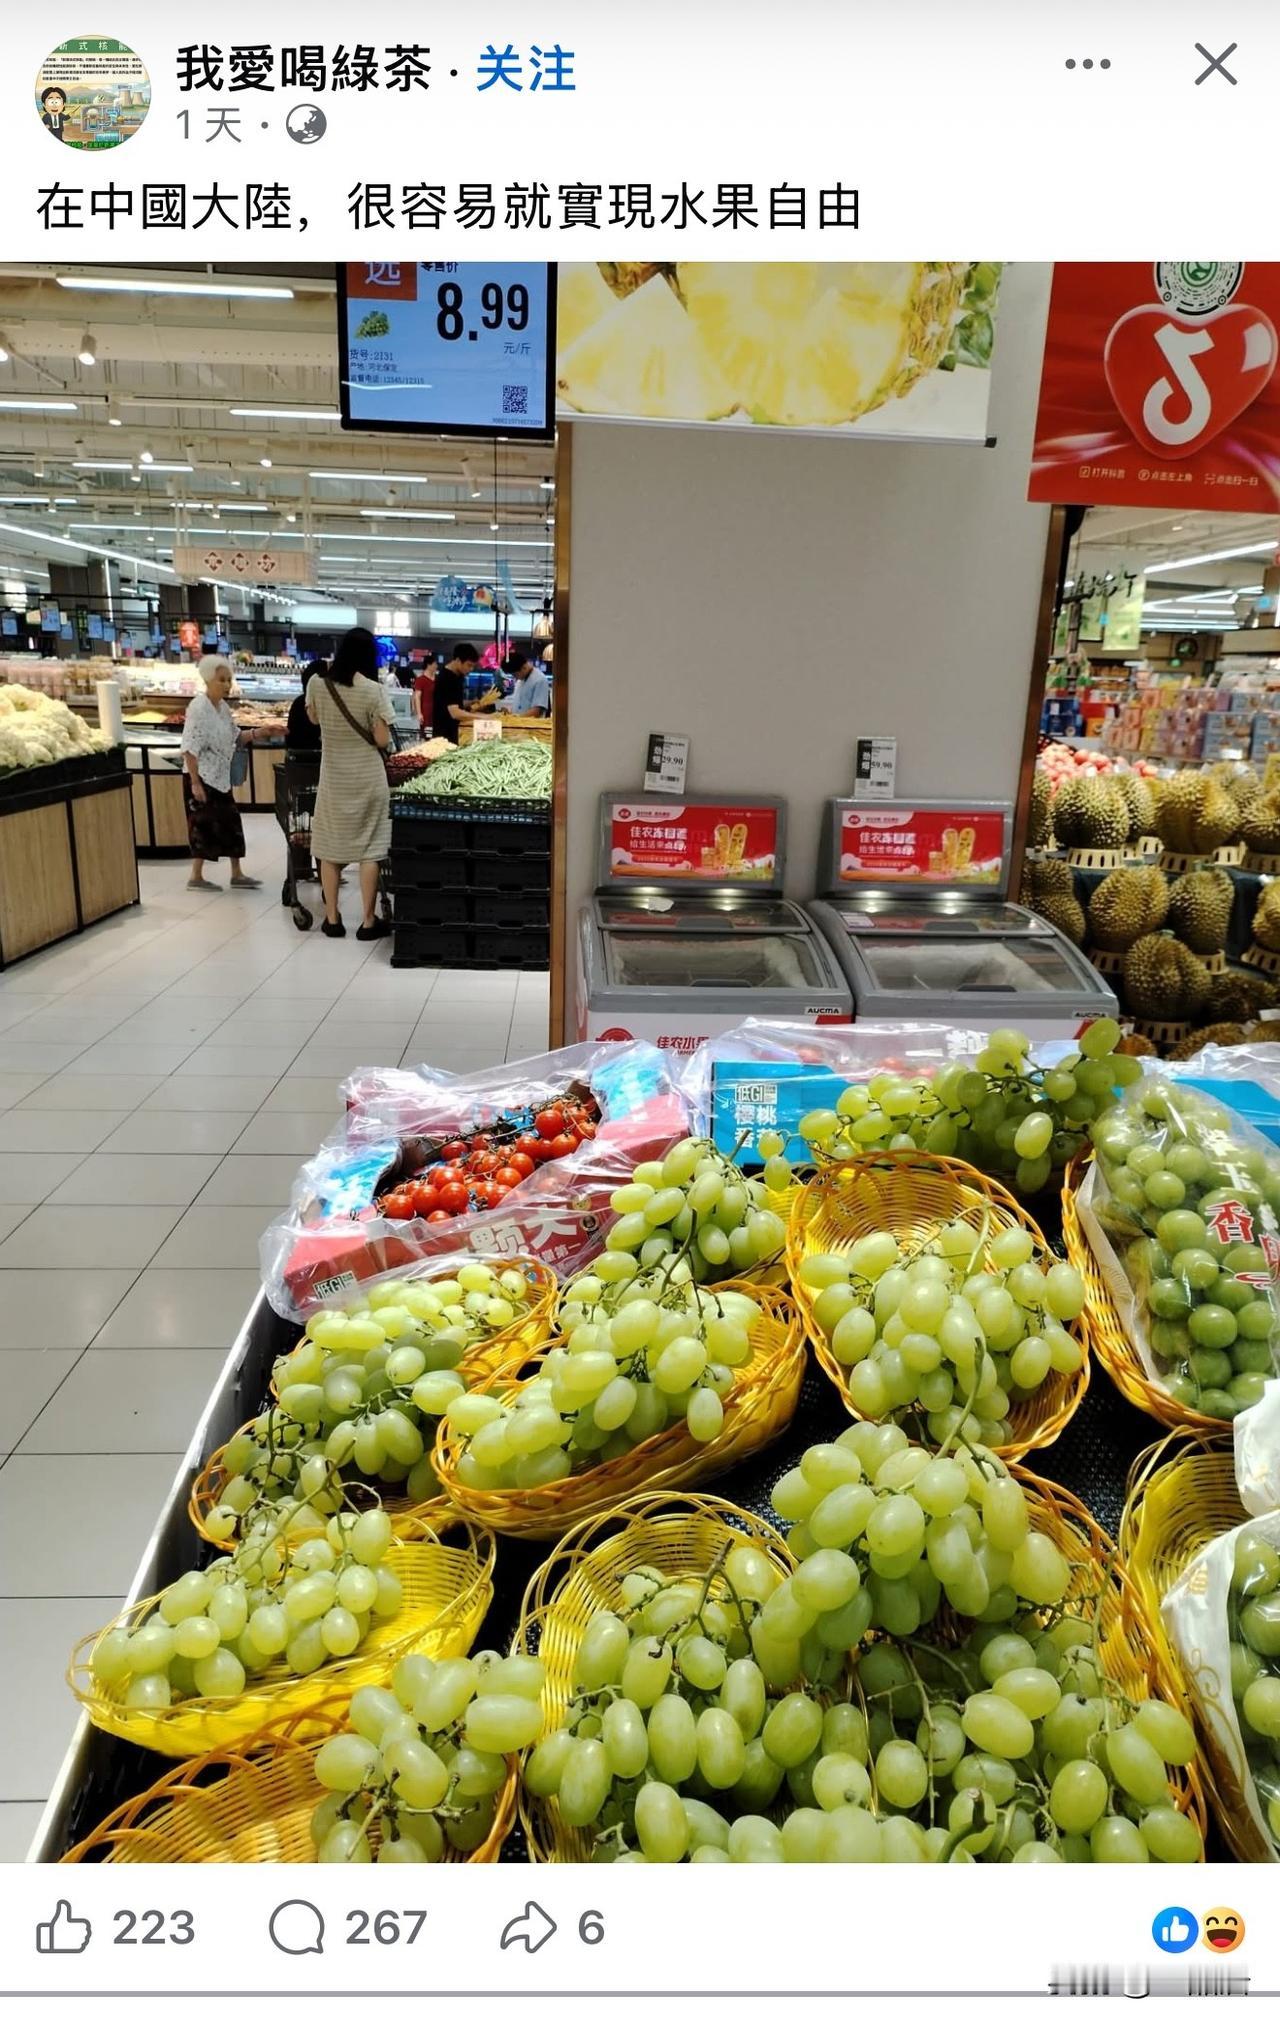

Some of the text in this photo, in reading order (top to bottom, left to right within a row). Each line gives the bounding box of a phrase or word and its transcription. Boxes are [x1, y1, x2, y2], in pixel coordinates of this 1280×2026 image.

[437, 282, 529, 341] 8.99
[503, 342, 531, 355] 元/斤
[1092, 467, 1259, 486] 打开抖音 点击左上角 点击扫一扫
